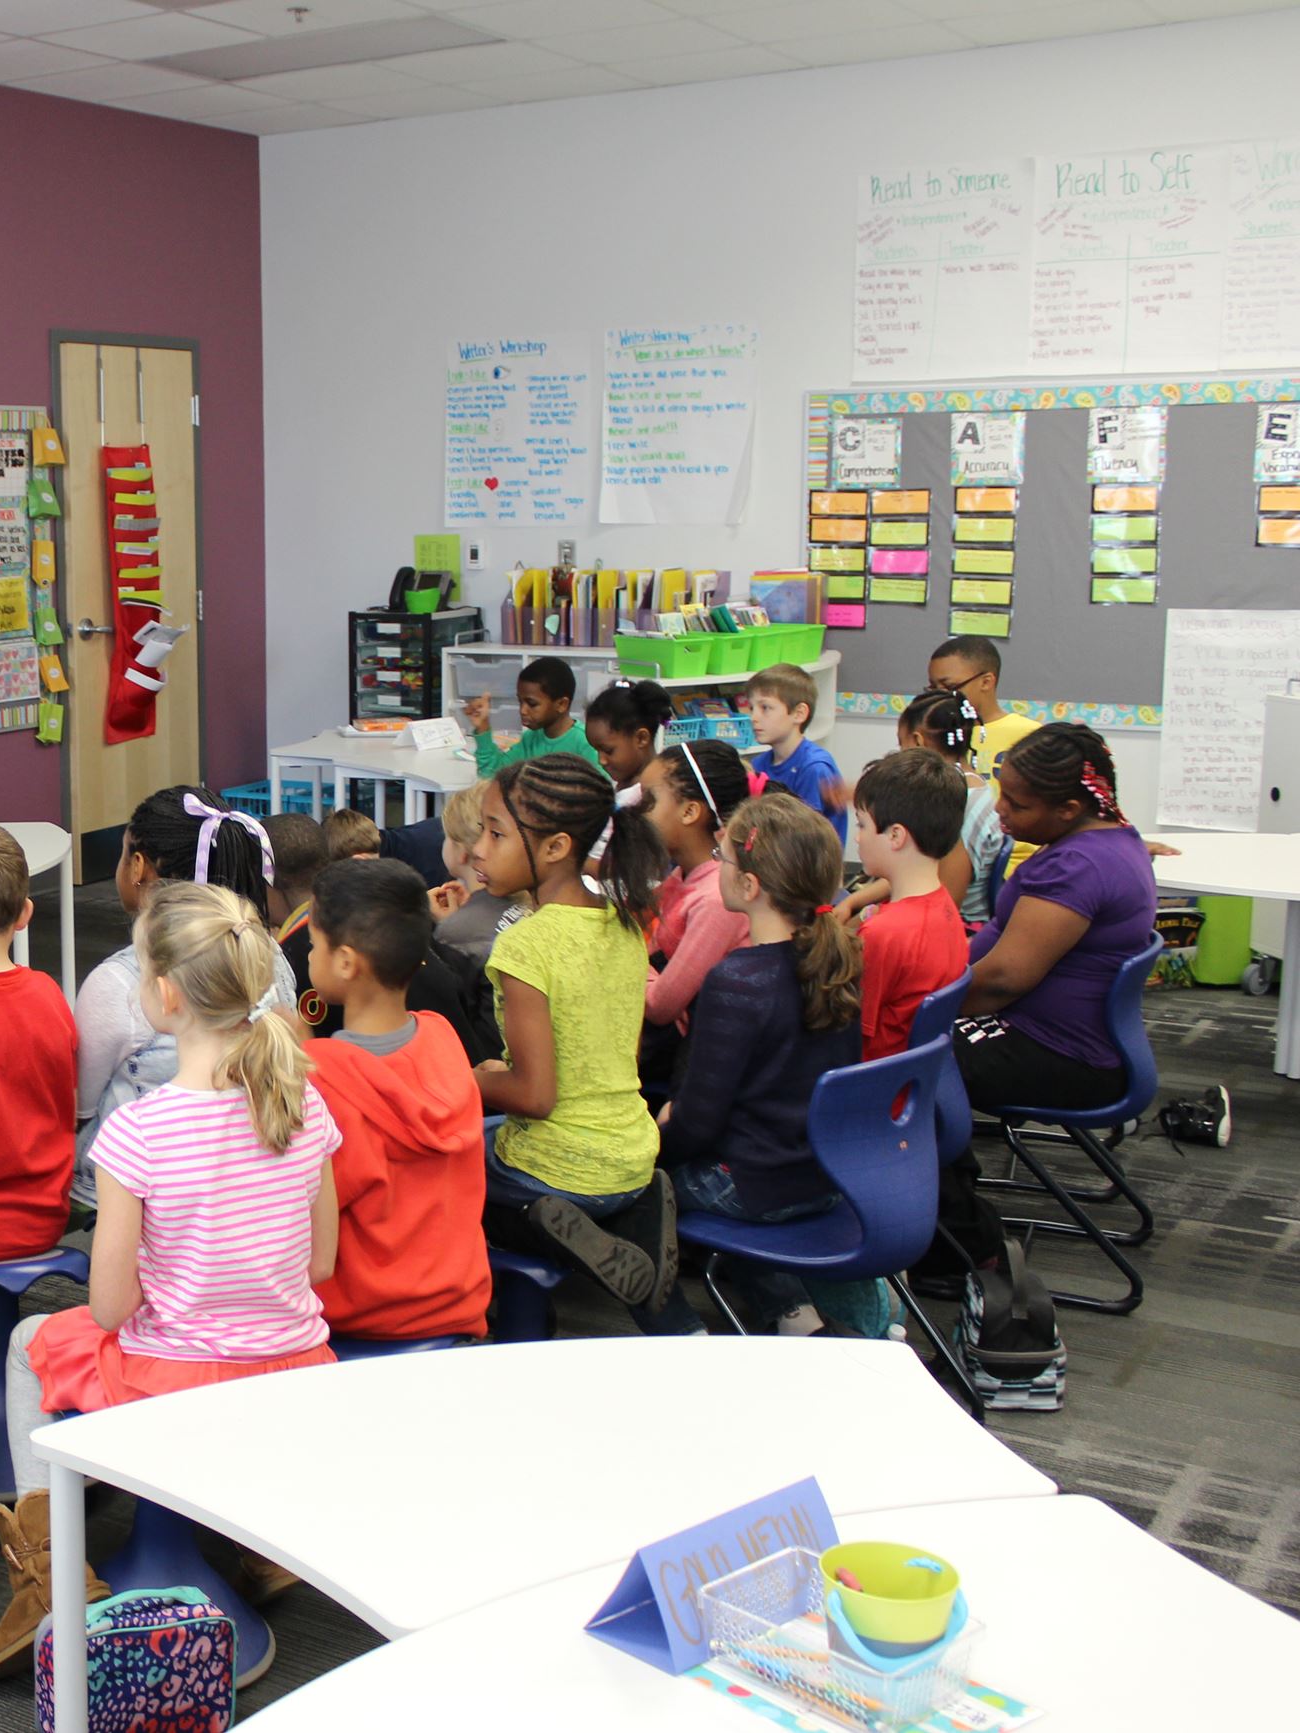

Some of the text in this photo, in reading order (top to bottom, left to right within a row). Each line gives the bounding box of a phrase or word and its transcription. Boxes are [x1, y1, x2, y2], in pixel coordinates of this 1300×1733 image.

[870, 168, 1011, 205] Read to Someone
[1055, 151, 1193, 199] Read to Self
[499, 339, 546, 357] Workshop
[838, 426, 861, 451] C
[957, 421, 981, 446] A
[1097, 414, 1119, 444] F
[1263, 413, 1292, 442] E
[963, 461, 1010, 475] Accuracy
[1093, 457, 1140, 473] Fluency
